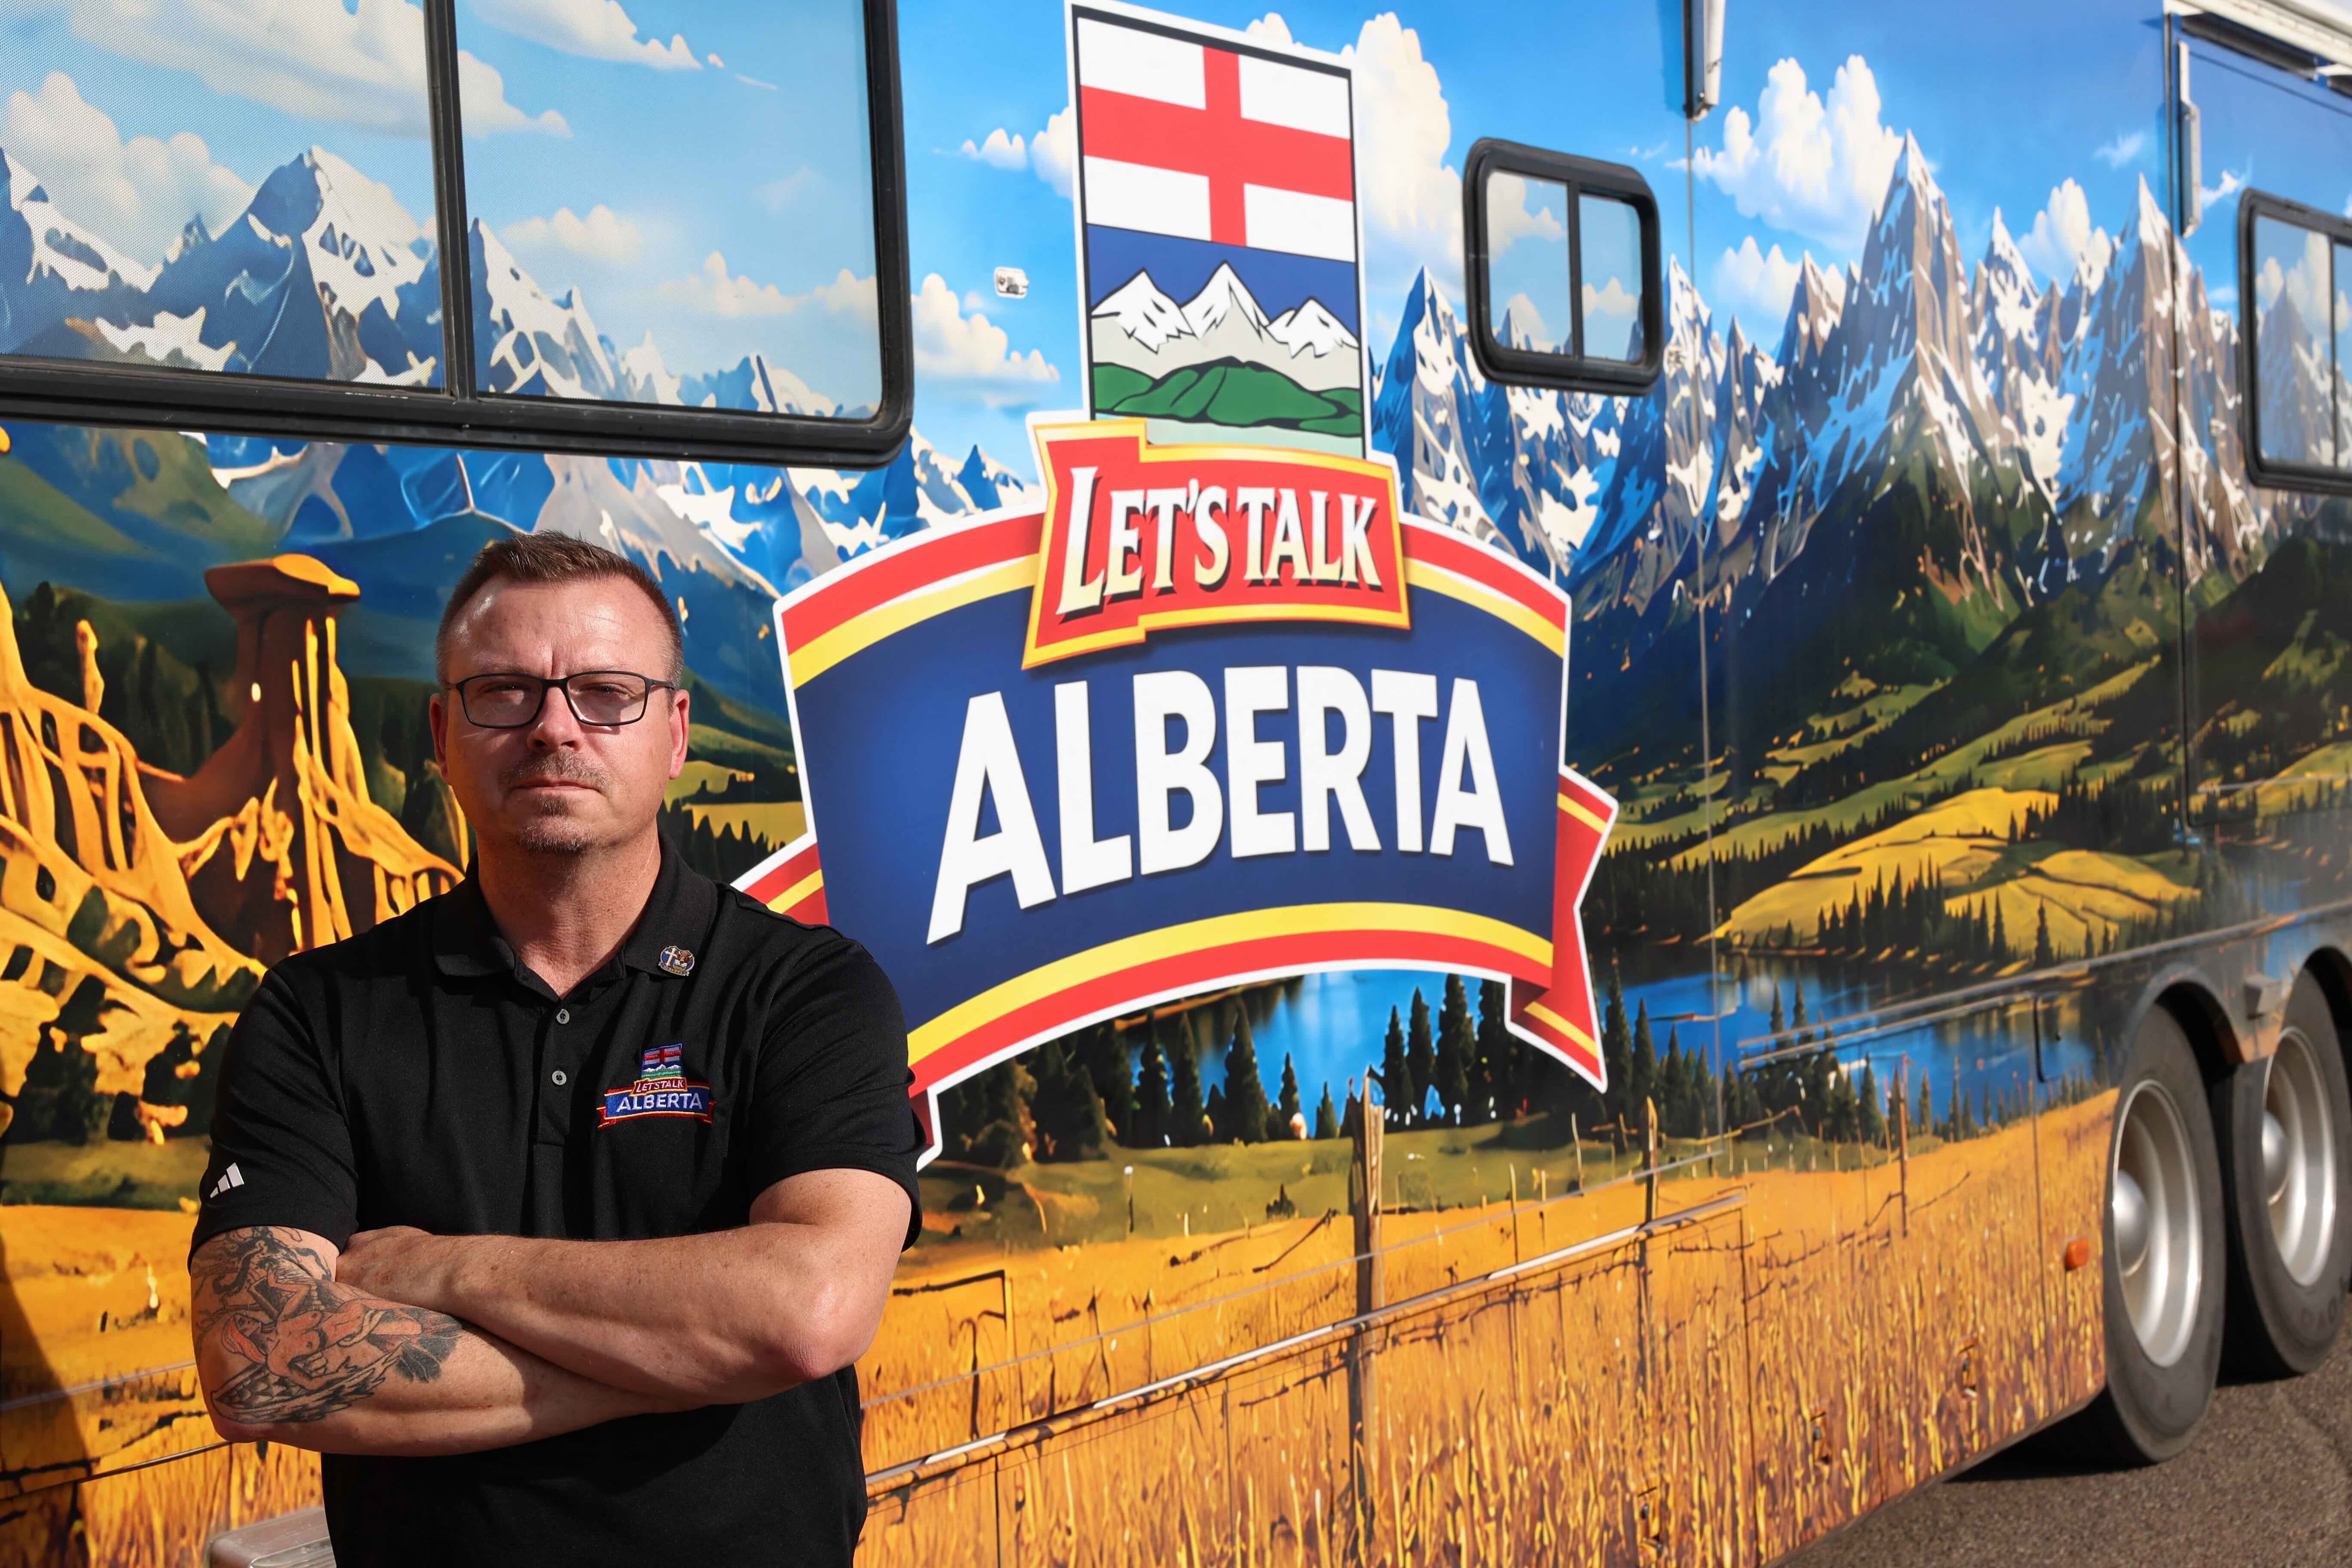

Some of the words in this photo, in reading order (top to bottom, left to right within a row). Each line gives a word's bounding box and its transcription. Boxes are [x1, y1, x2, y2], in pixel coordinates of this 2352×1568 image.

[1055, 466, 1229, 615] LET'S
[1236, 486, 1383, 588] TALK
[926, 665, 1515, 945] ALBERTA
[616, 1092, 703, 1112] ALBERTA
[636, 1082, 660, 1092] LET'S
[660, 1080, 683, 1089] TALK
